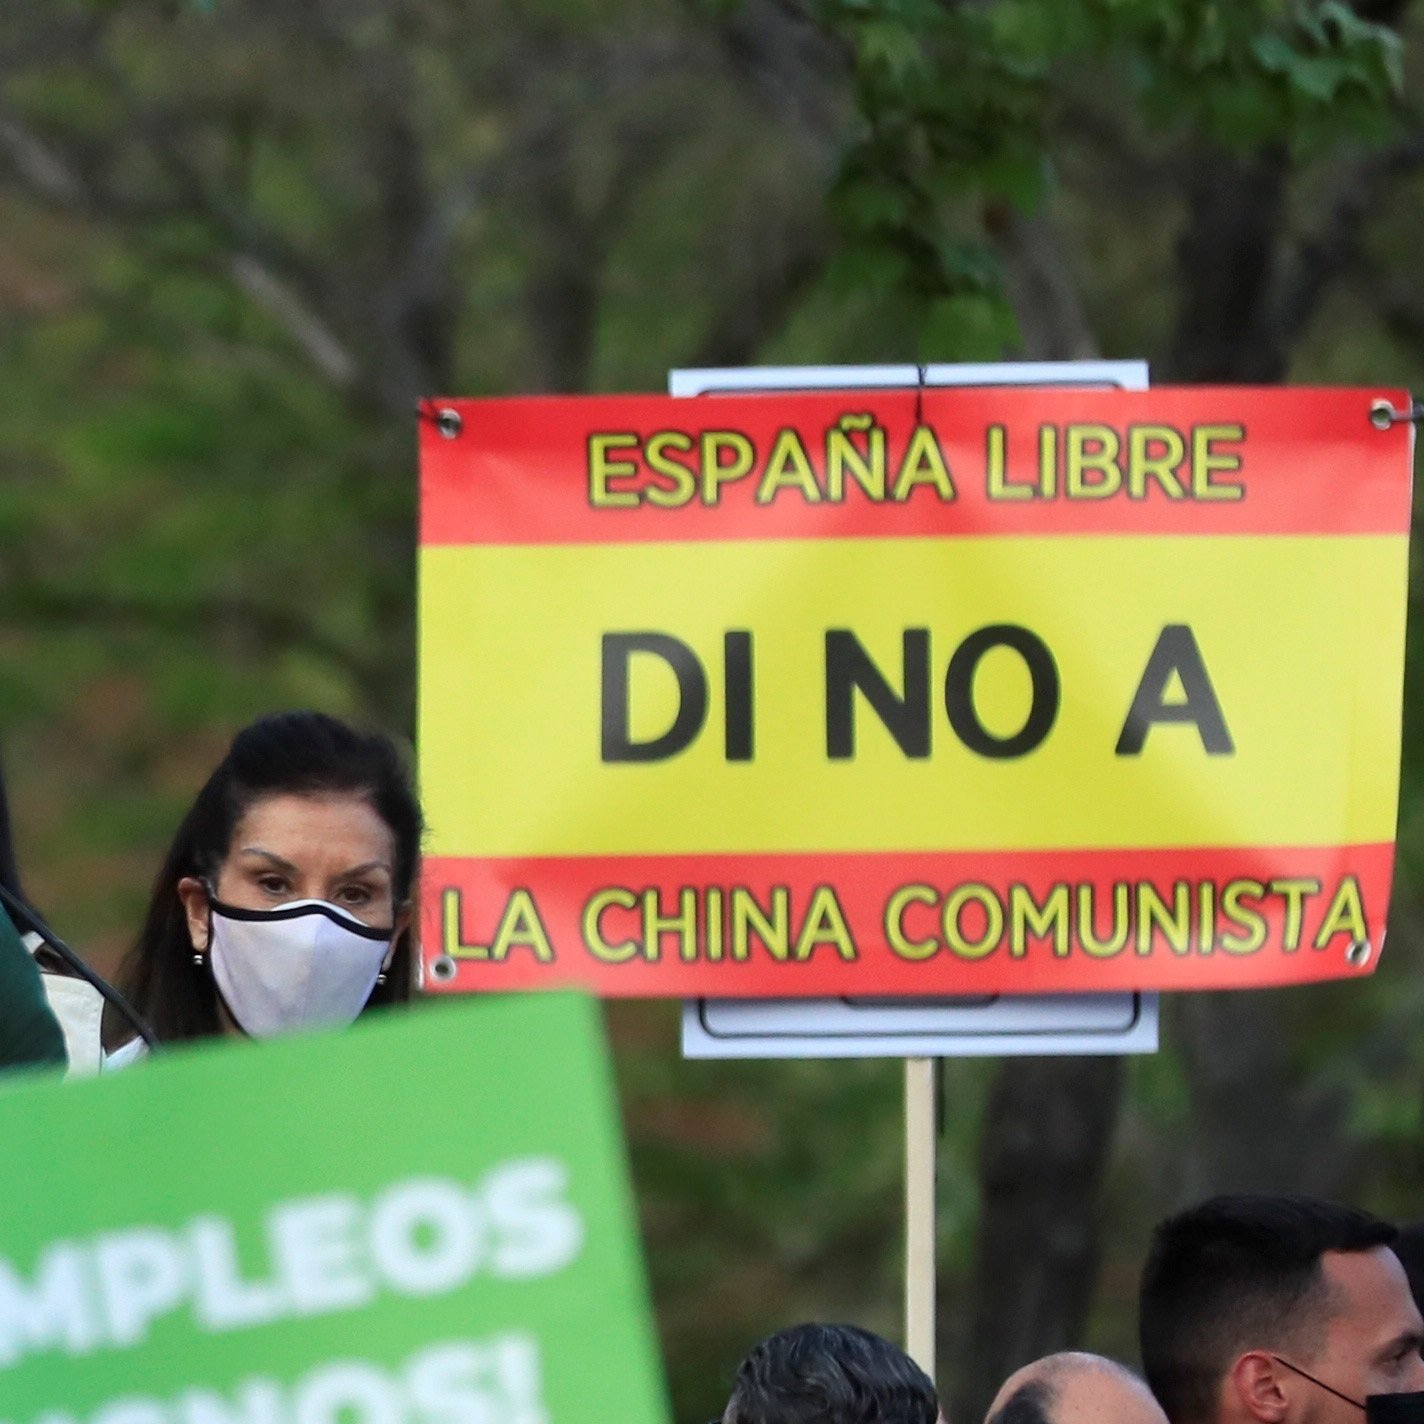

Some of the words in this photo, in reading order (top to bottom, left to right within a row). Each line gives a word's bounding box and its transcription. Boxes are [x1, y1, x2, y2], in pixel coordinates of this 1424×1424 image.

[586, 414, 956, 509] ESPAÑA
[986, 422, 1248, 502] LIBRE
[599, 628, 756, 764] DI
[823, 623, 1061, 761] NO
[1114, 622, 1236, 757] A
[440, 886, 555, 965] LA
[581, 883, 859, 963] CHINA
[884, 874, 1369, 961] COMUNISTA
